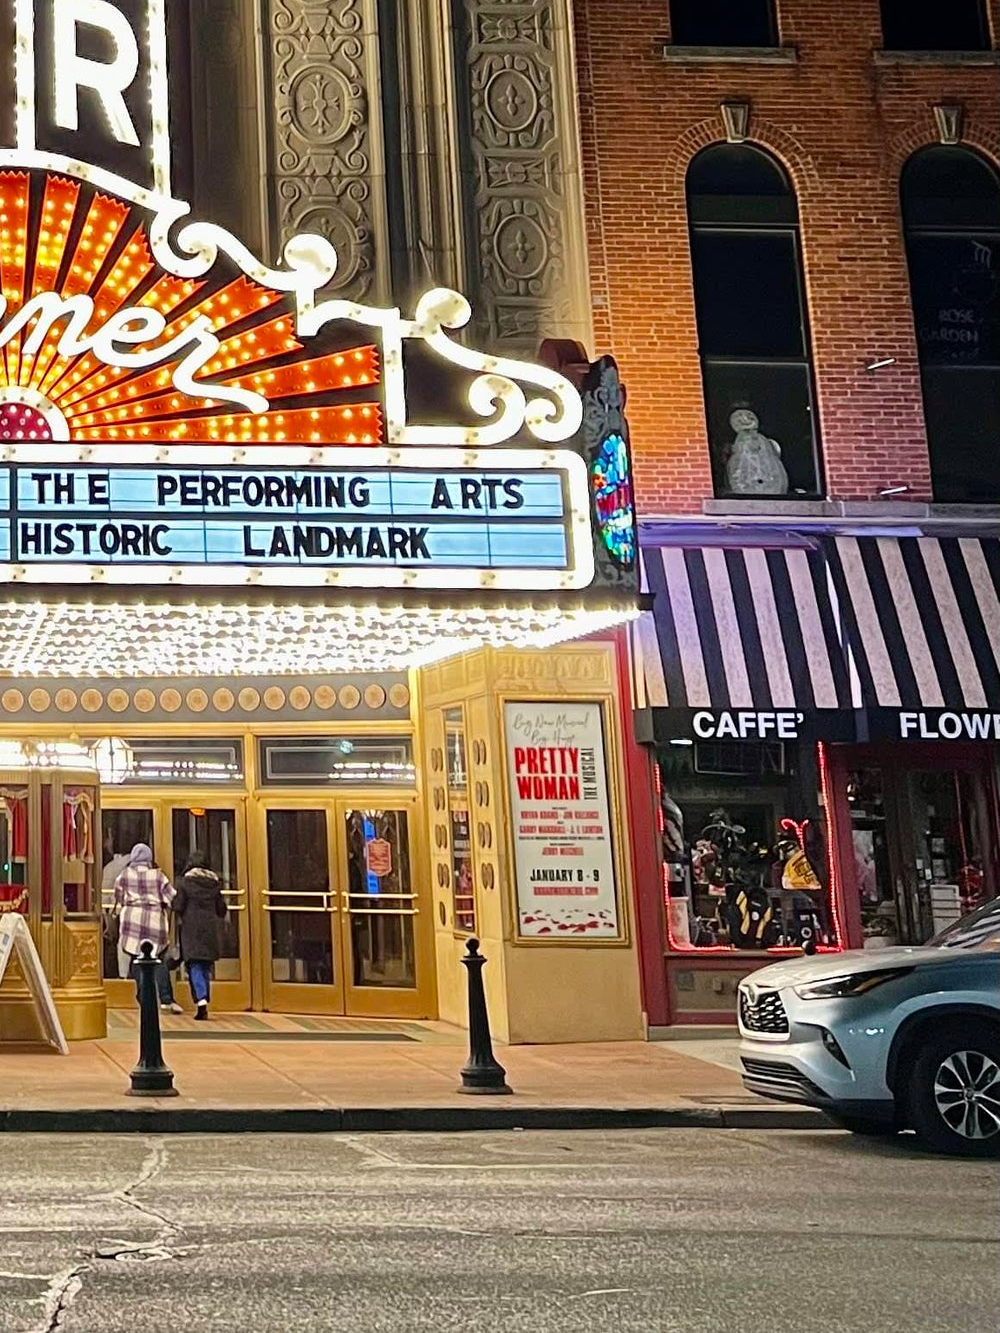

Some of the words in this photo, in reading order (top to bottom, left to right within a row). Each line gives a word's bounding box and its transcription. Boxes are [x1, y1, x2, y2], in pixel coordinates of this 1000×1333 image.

[31, 472, 110, 505] THE
[157, 474, 371, 509] PERFORMING
[431, 478, 525, 511] ARTS
[20, 521, 174, 557] HISTORIC
[243, 525, 432, 559] LANDMARK
[514, 747, 579, 774] PRETTY
[580, 748, 597, 784] MUSICAL
[516, 776, 580, 800] WOMAN
[530, 869, 573, 882] JANUARY
[593, 869, 600, 882] 9
